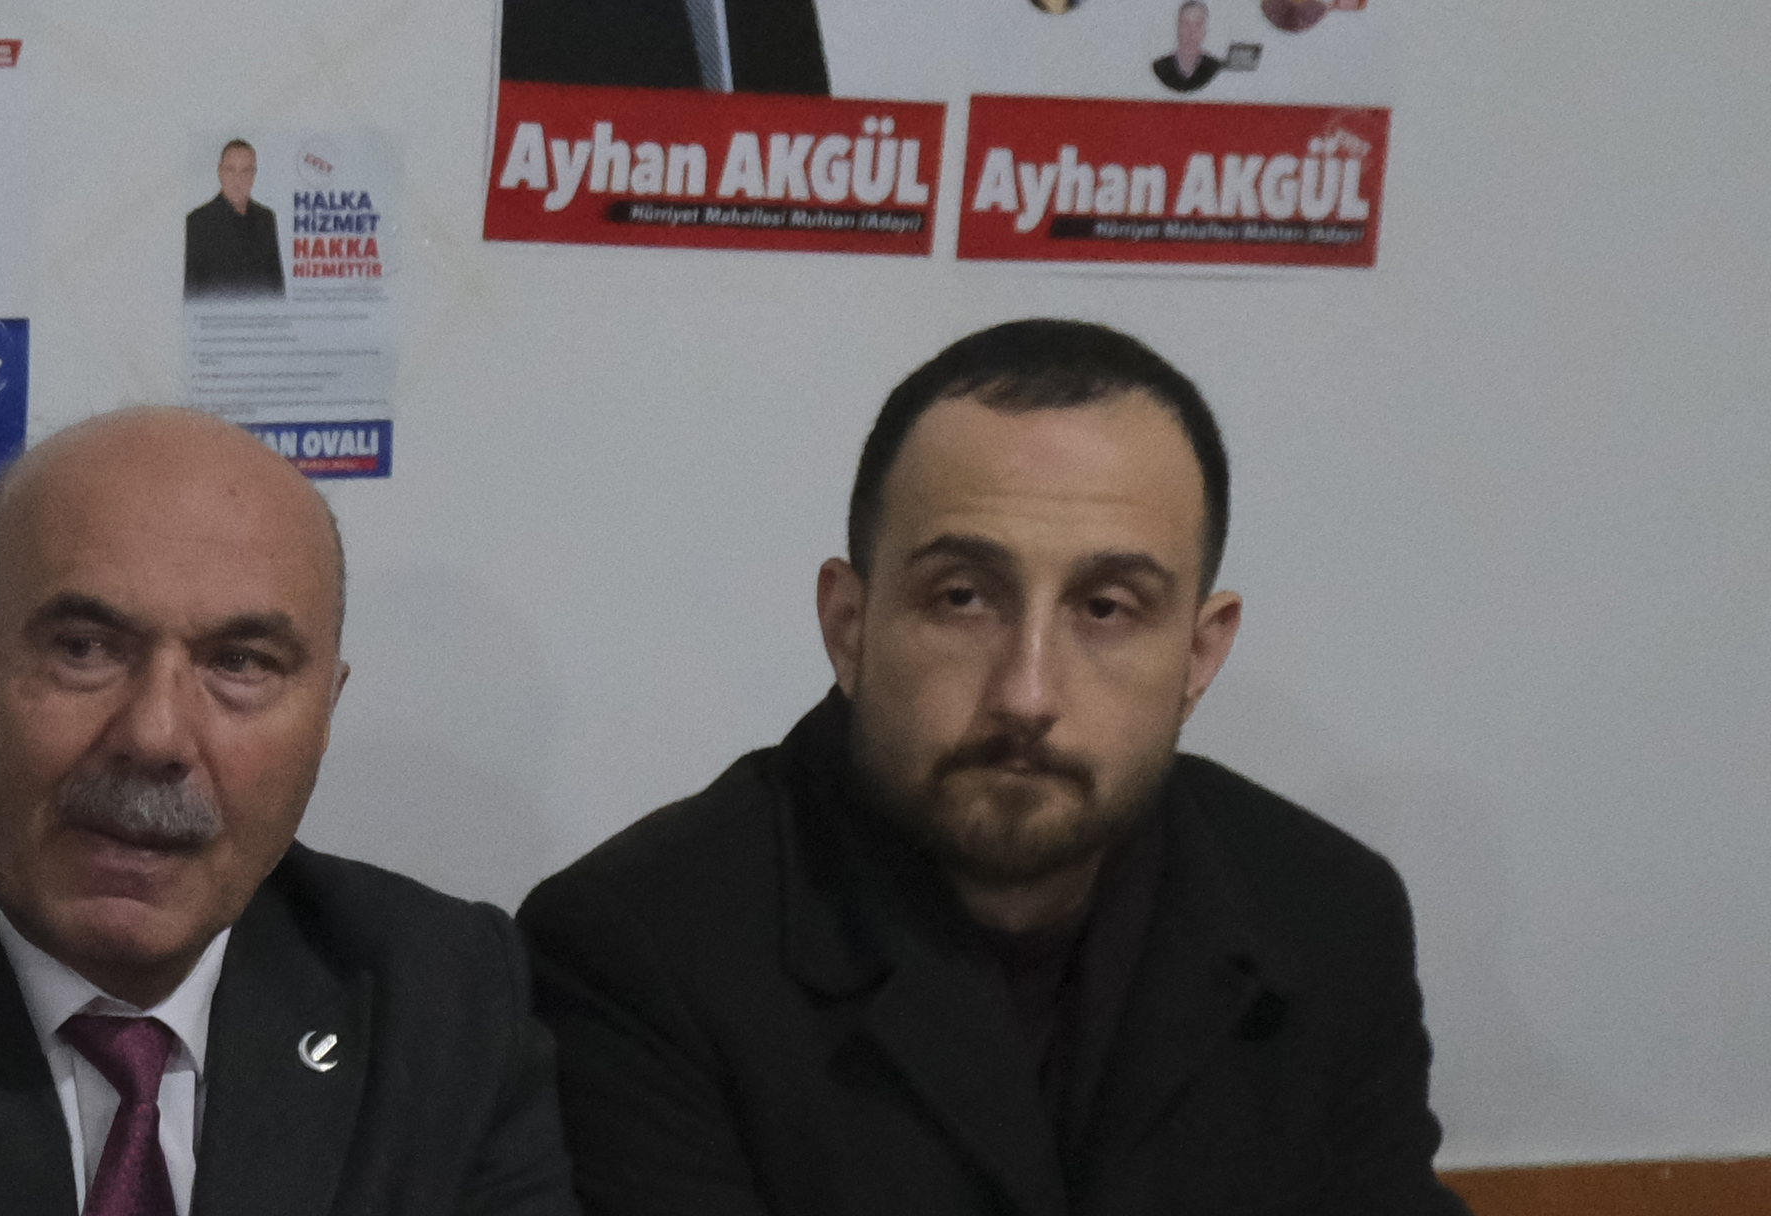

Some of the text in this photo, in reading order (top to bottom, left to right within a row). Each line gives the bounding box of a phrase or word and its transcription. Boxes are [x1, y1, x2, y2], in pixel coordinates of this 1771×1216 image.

[499, 115, 930, 213] Ayhan AKGÜL
[972, 136, 1369, 234] Ayhan AKGÜL
[293, 190, 373, 210] HALKA
[293, 212, 381, 234] HİZMET
[630, 204, 700, 227] Hürriyet
[705, 207, 786, 225] Mahallesi
[293, 236, 379, 259] HAKKA
[303, 427, 380, 458] OVALI
